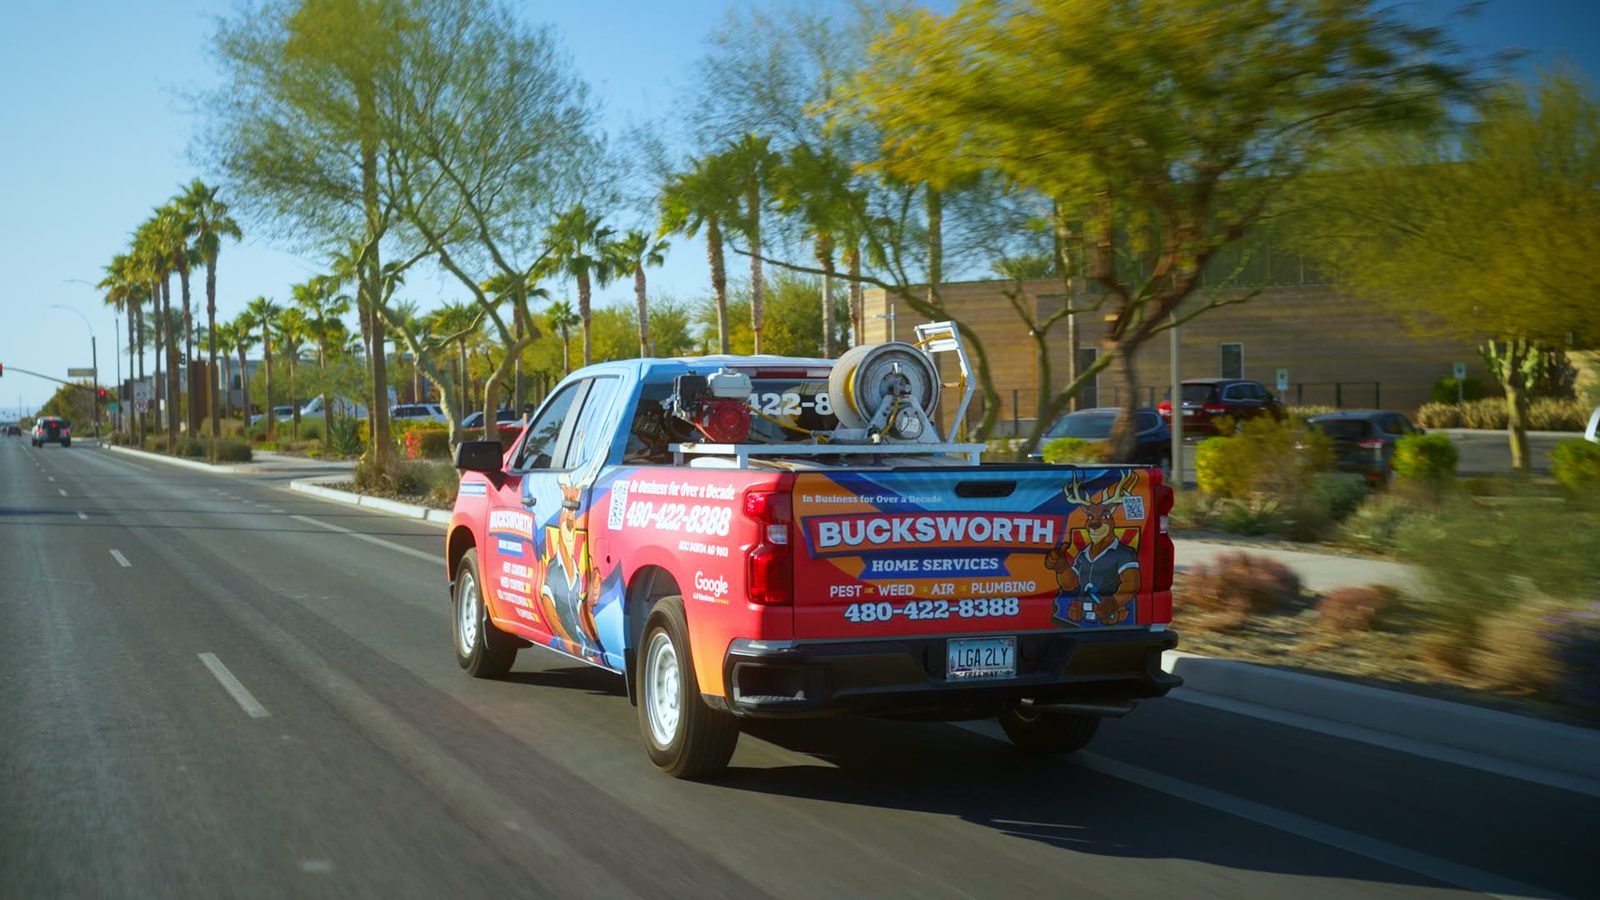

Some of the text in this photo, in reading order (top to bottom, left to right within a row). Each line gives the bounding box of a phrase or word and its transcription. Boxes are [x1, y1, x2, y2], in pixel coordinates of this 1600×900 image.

[630, 480, 735, 501] In Business for Over a Decade
[802, 495, 813, 503] In
[815, 495, 858, 504] Business
[860, 495, 874, 504] for
[876, 495, 899, 504] Over
[909, 494, 942, 504] Decade
[626, 501, 732, 537] 480-422-8388
[818, 516, 1055, 548] BUCKSWORTH
[871, 557, 999, 573] HOME SERVICES
[695, 570, 728, 598] Google
[830, 581, 1036, 598] PEST WEED AIR PLUMBING
[843, 597, 1020, 622] 480-422-8388
[958, 647, 1008, 668] LGA 2LY
